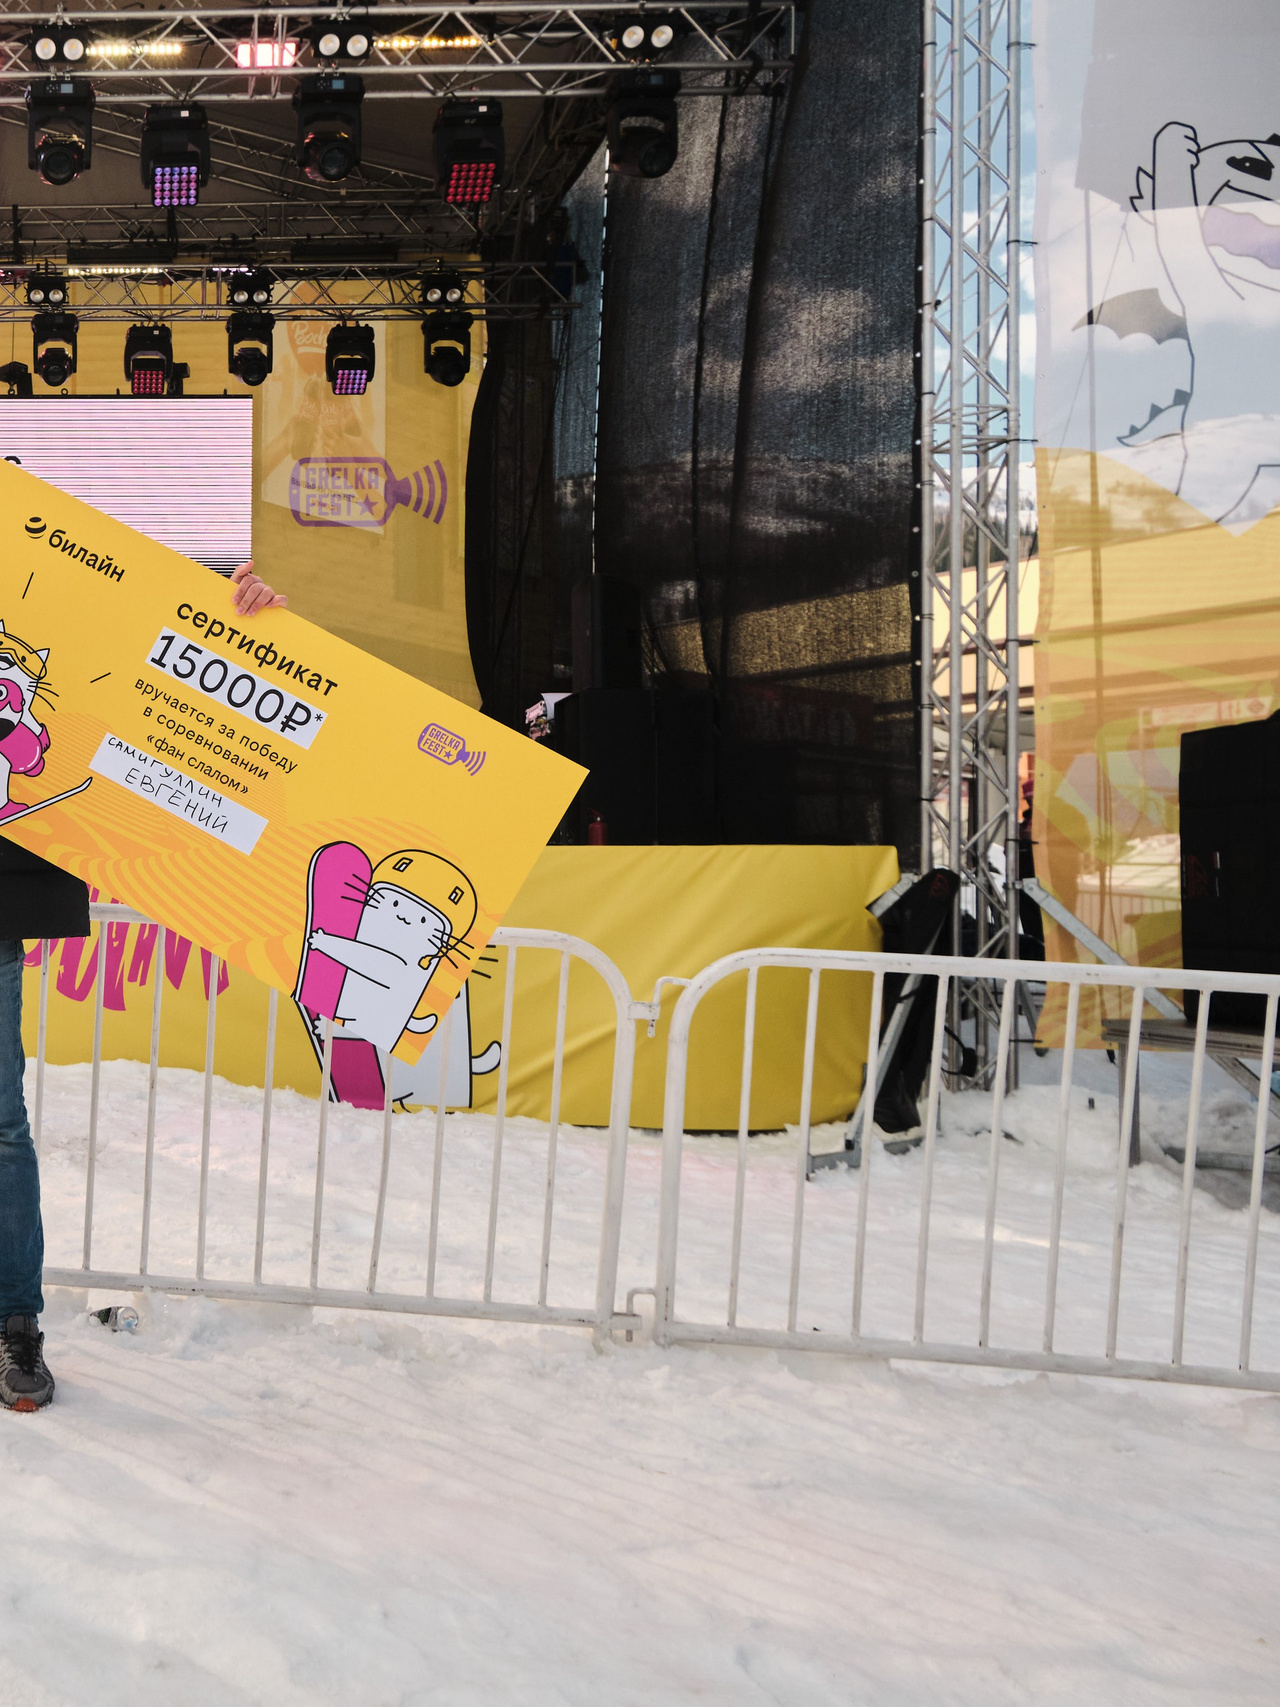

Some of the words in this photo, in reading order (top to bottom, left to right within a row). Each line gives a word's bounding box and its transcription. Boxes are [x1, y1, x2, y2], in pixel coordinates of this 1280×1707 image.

[305, 467, 379, 490] GRELKA
[305, 493, 353, 516] FEST
[48, 528, 126, 583] билайн
[176, 602, 338, 697] сертификат
[134, 678, 215, 728] вручается
[218, 724, 236, 740] за
[239, 735, 298, 774] победу
[143, 706, 153, 717] в
[156, 712, 269, 781] соревновании
[422, 737, 446, 755] FEST
[428, 727, 461, 751] GRELKA
[146, 732, 185, 761] «фан
[188, 756, 249, 795] слалом»
[124, 767, 228, 833] ЕВГЕНИЙ
